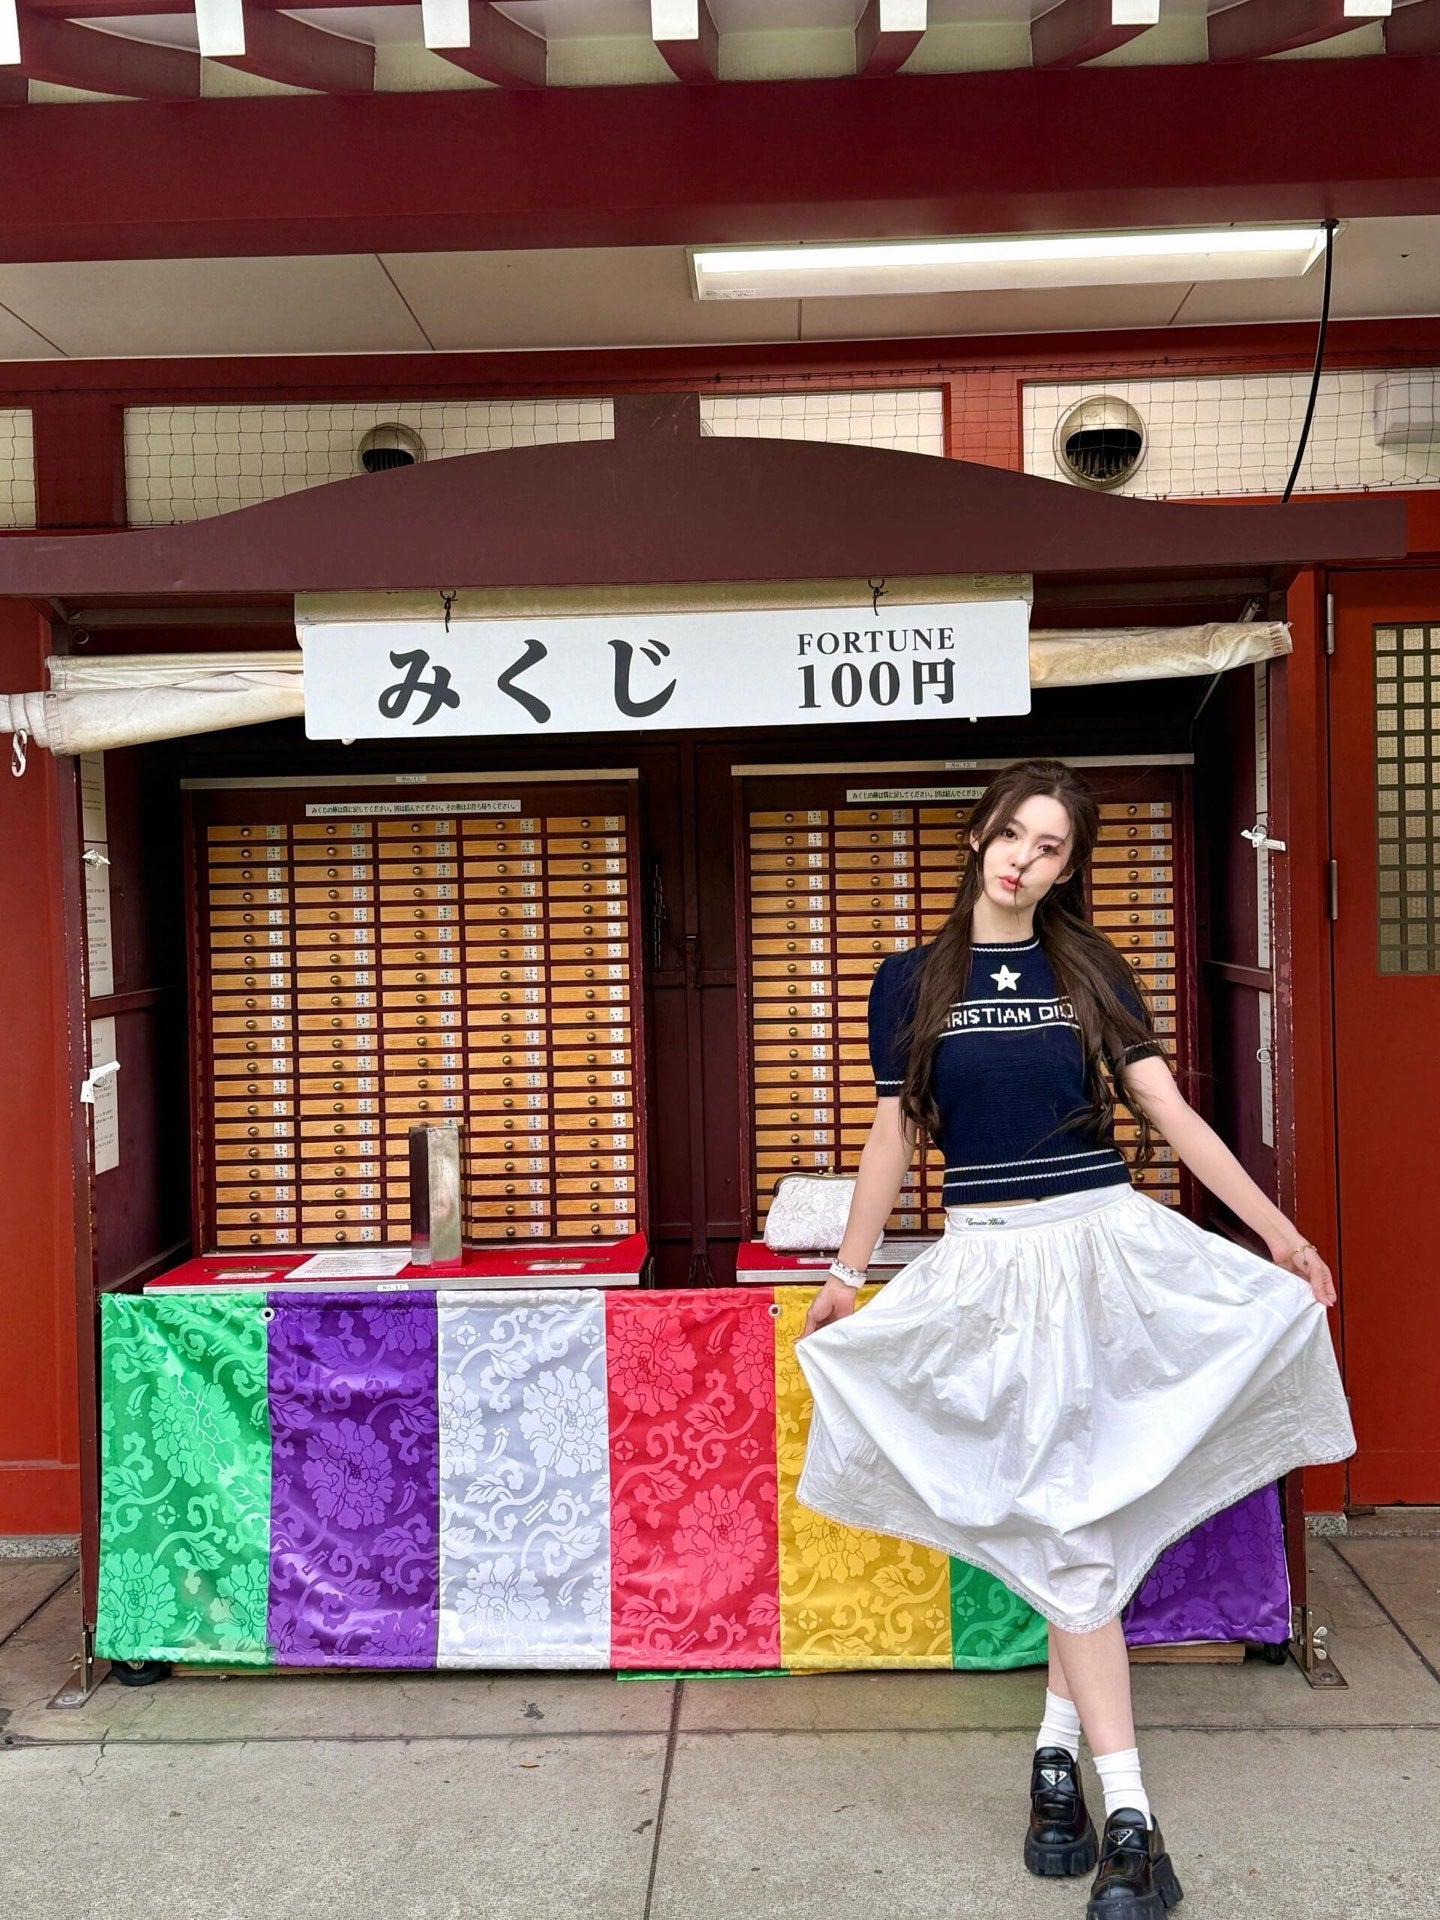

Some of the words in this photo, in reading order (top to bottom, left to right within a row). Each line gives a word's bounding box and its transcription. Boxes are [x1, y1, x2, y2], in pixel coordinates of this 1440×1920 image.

[797, 628, 956, 656] FORTUNE
[379, 639, 677, 726] みくじ
[797, 657, 956, 709] 100円
[944, 1007, 1032, 1028] RISTIAN
[1038, 1003, 1078, 1021] DIO
